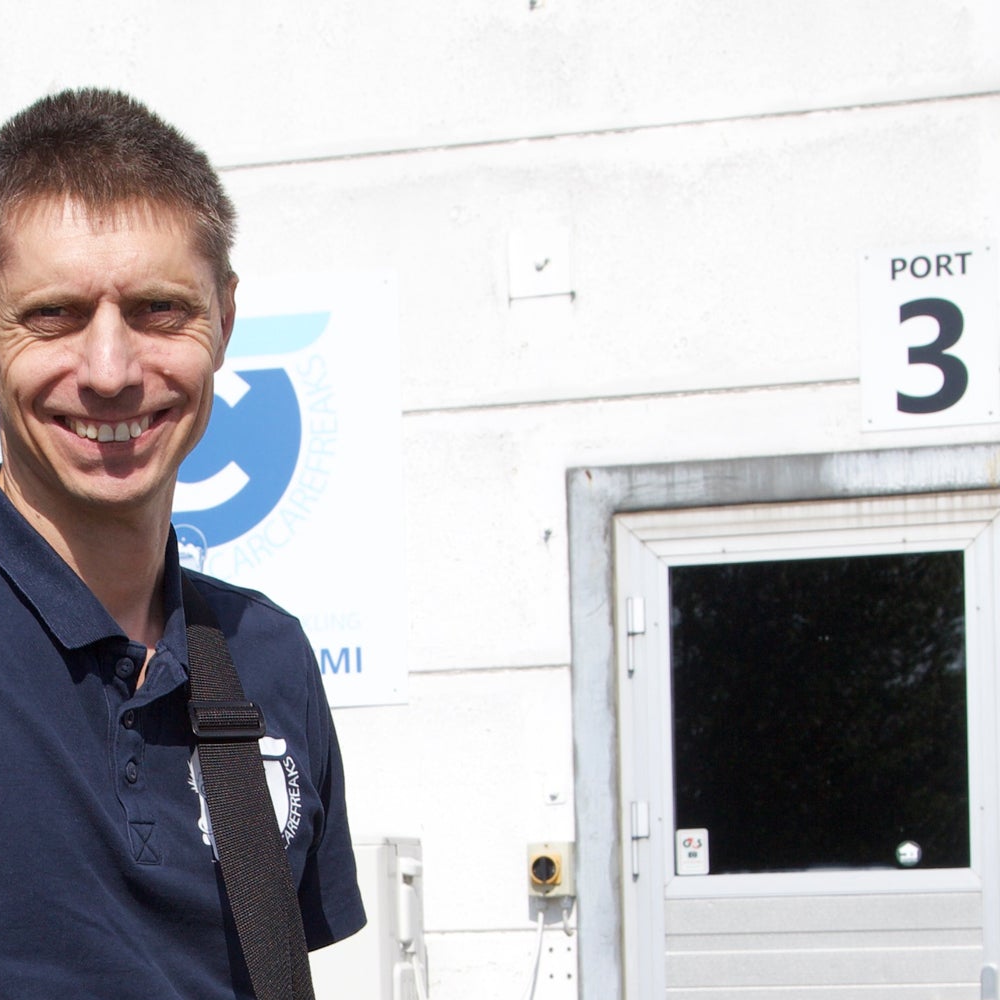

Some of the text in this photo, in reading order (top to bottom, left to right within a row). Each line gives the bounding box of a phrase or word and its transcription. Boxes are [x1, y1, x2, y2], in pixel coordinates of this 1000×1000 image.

[890, 252, 973, 281] PORT
[896, 297, 970, 415] 3
[318, 645, 363, 676] MI
[281, 755, 303, 850] AREFREAKS
